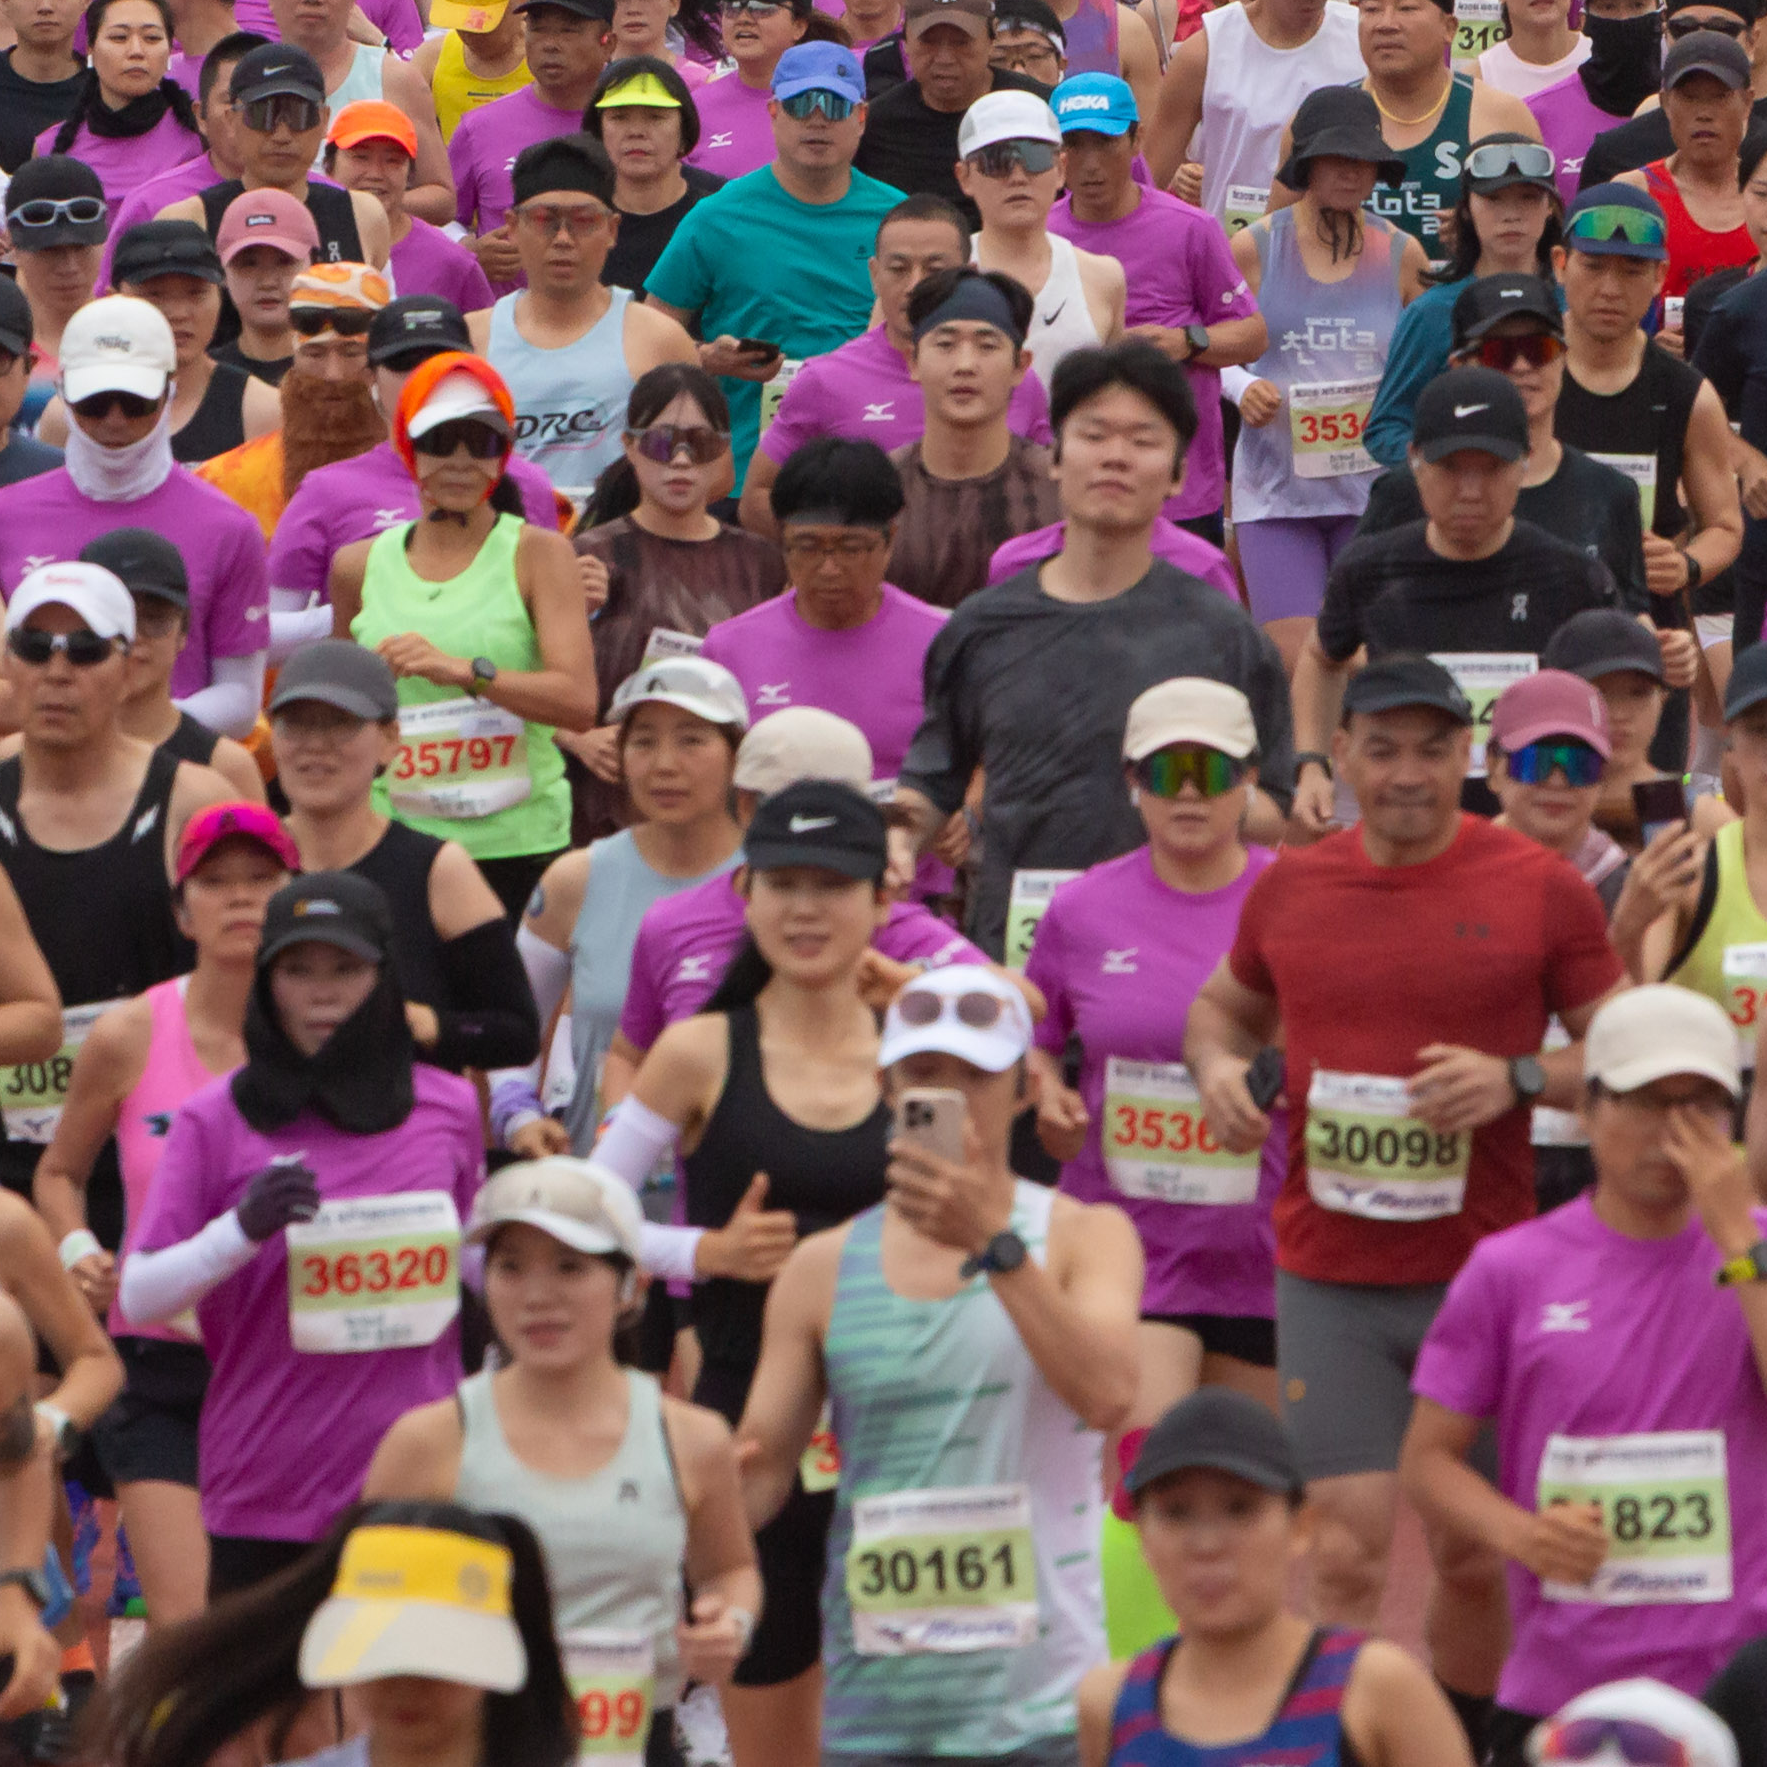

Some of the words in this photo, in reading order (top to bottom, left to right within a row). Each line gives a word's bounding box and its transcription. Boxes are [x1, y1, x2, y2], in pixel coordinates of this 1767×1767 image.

[1059, 94, 1110, 115] HOKA
[394, 735, 518, 781] 35797
[302, 1244, 448, 1297] 36320
[857, 1543, 1017, 1597] 30161
